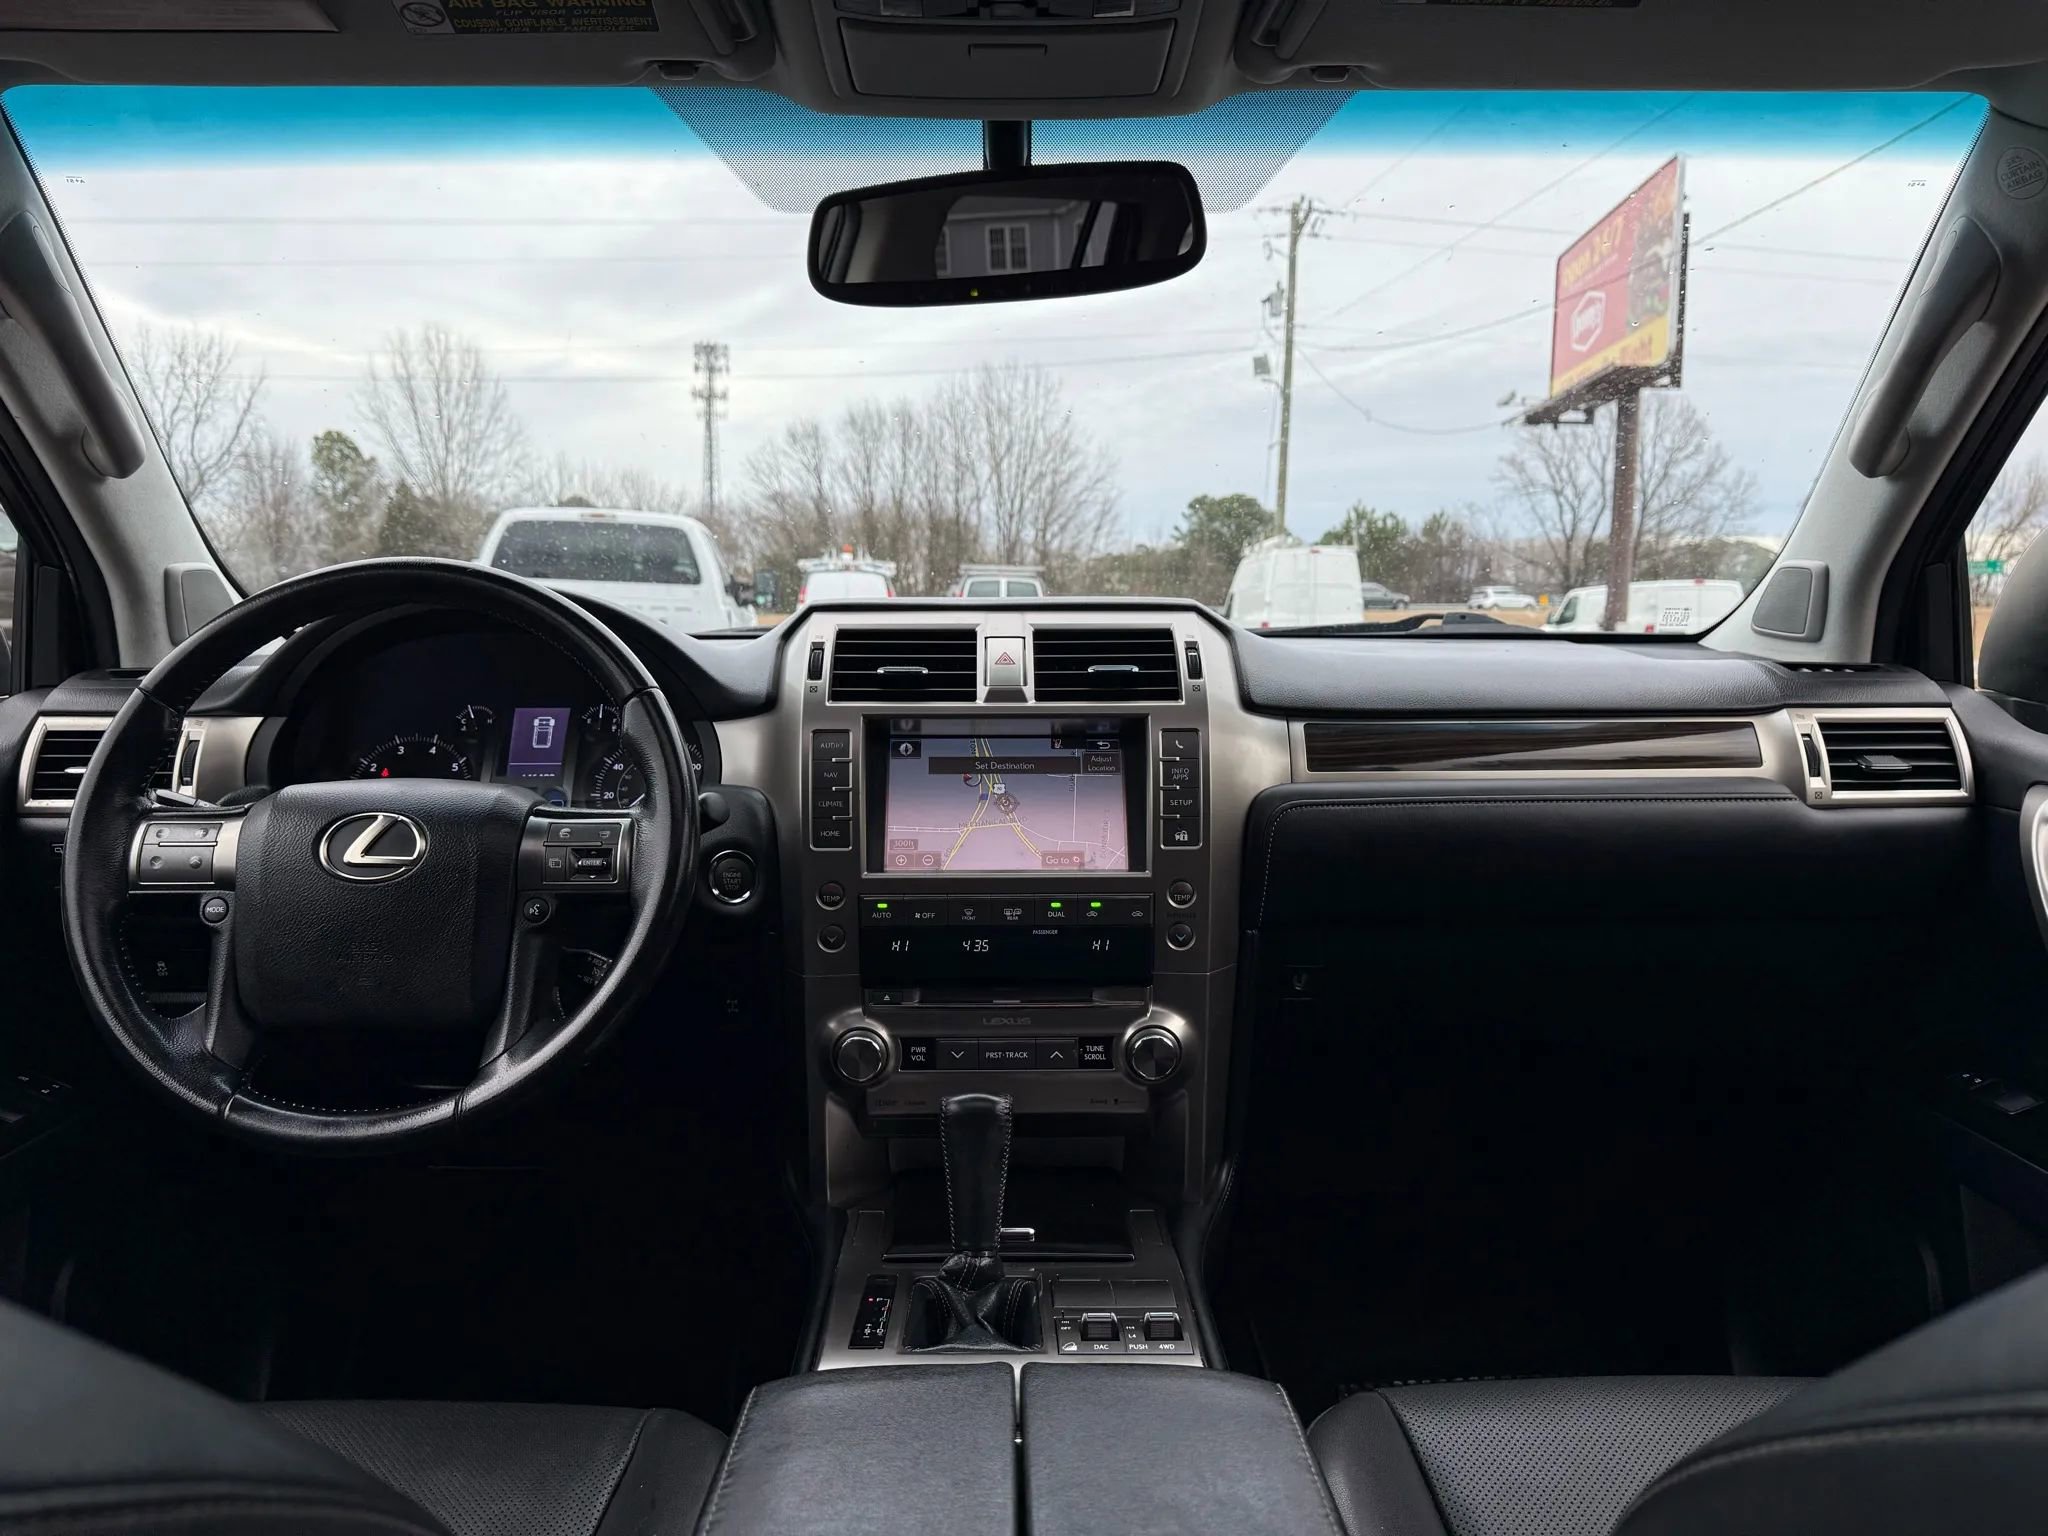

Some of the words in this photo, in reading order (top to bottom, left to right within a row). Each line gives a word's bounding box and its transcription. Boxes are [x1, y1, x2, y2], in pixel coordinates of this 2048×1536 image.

[397, 746, 405, 755] 3
[428, 746, 437, 755] 4
[1090, 755, 1112, 764] Adjust
[370, 763, 377, 772] 2
[451, 763, 459, 772] 5
[613, 763, 624, 771] 40
[975, 762, 988, 770] Set
[990, 762, 1035, 770] Destination
[1088, 764, 1116, 772] Location
[603, 792, 615, 800] 20
[1046, 855, 1059, 864] Go
[1060, 856, 1070, 864] to
[822, 895, 841, 903] TEMP
[982, 1016, 1032, 1025] LEXUS
[911, 1046, 927, 1054] PWR
[1085, 1044, 1105, 1052] TUNE
[1084, 1053, 1106, 1061] SCROLL
